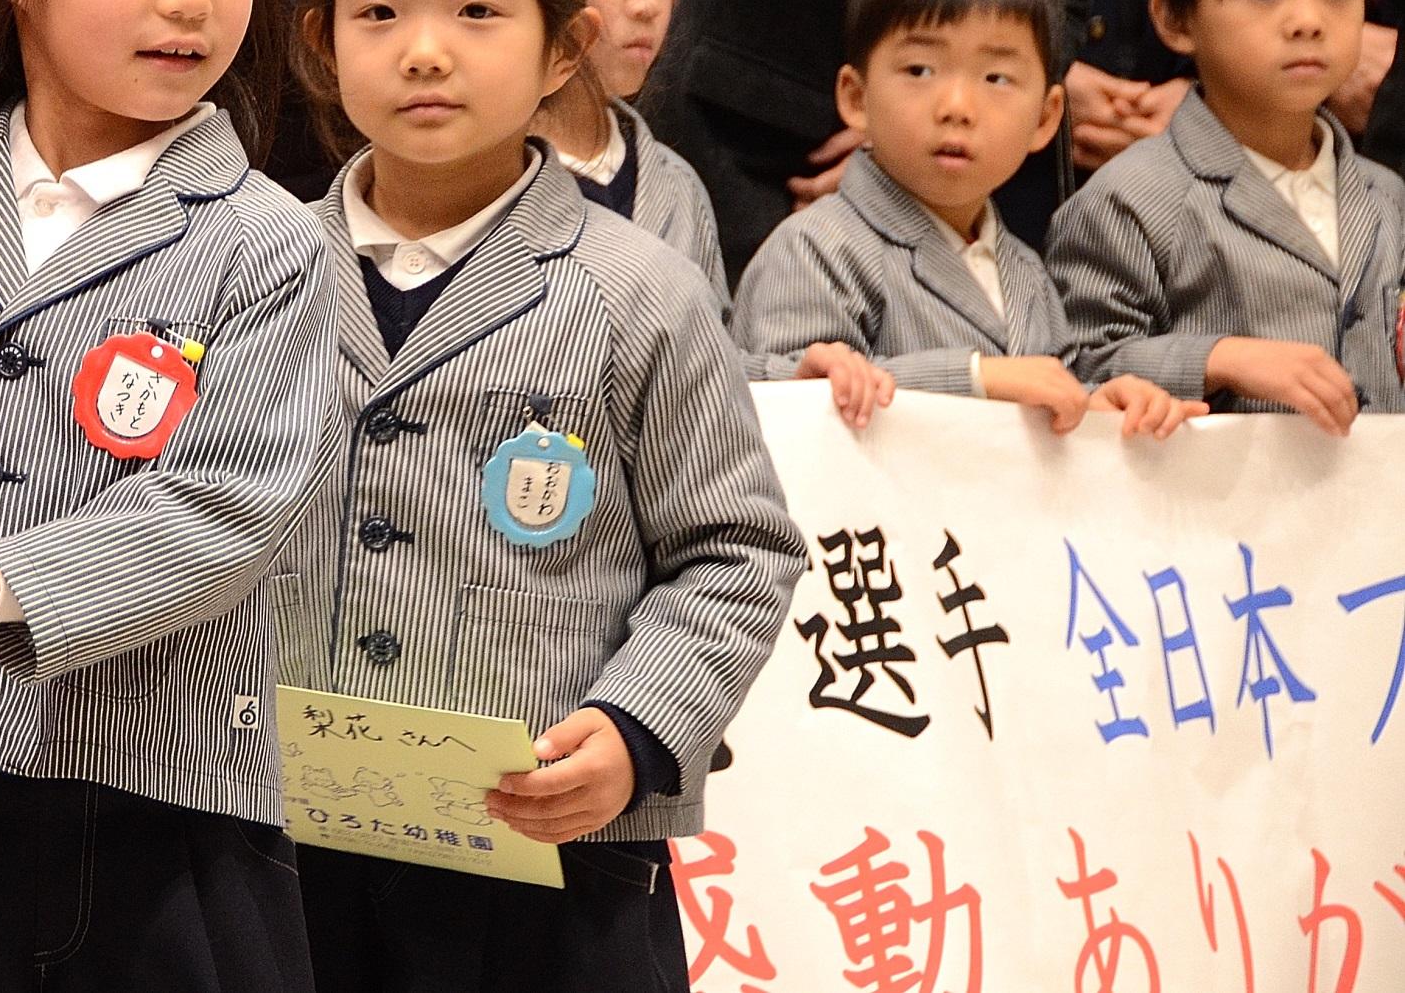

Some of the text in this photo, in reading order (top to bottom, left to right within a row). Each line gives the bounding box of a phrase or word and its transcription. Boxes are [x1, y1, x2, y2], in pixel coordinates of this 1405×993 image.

[708, 524, 1010, 773] 選手
[302, 704, 477, 753] 梨花 さんへ
[305, 807, 494, 851] ひろた幼稚園
